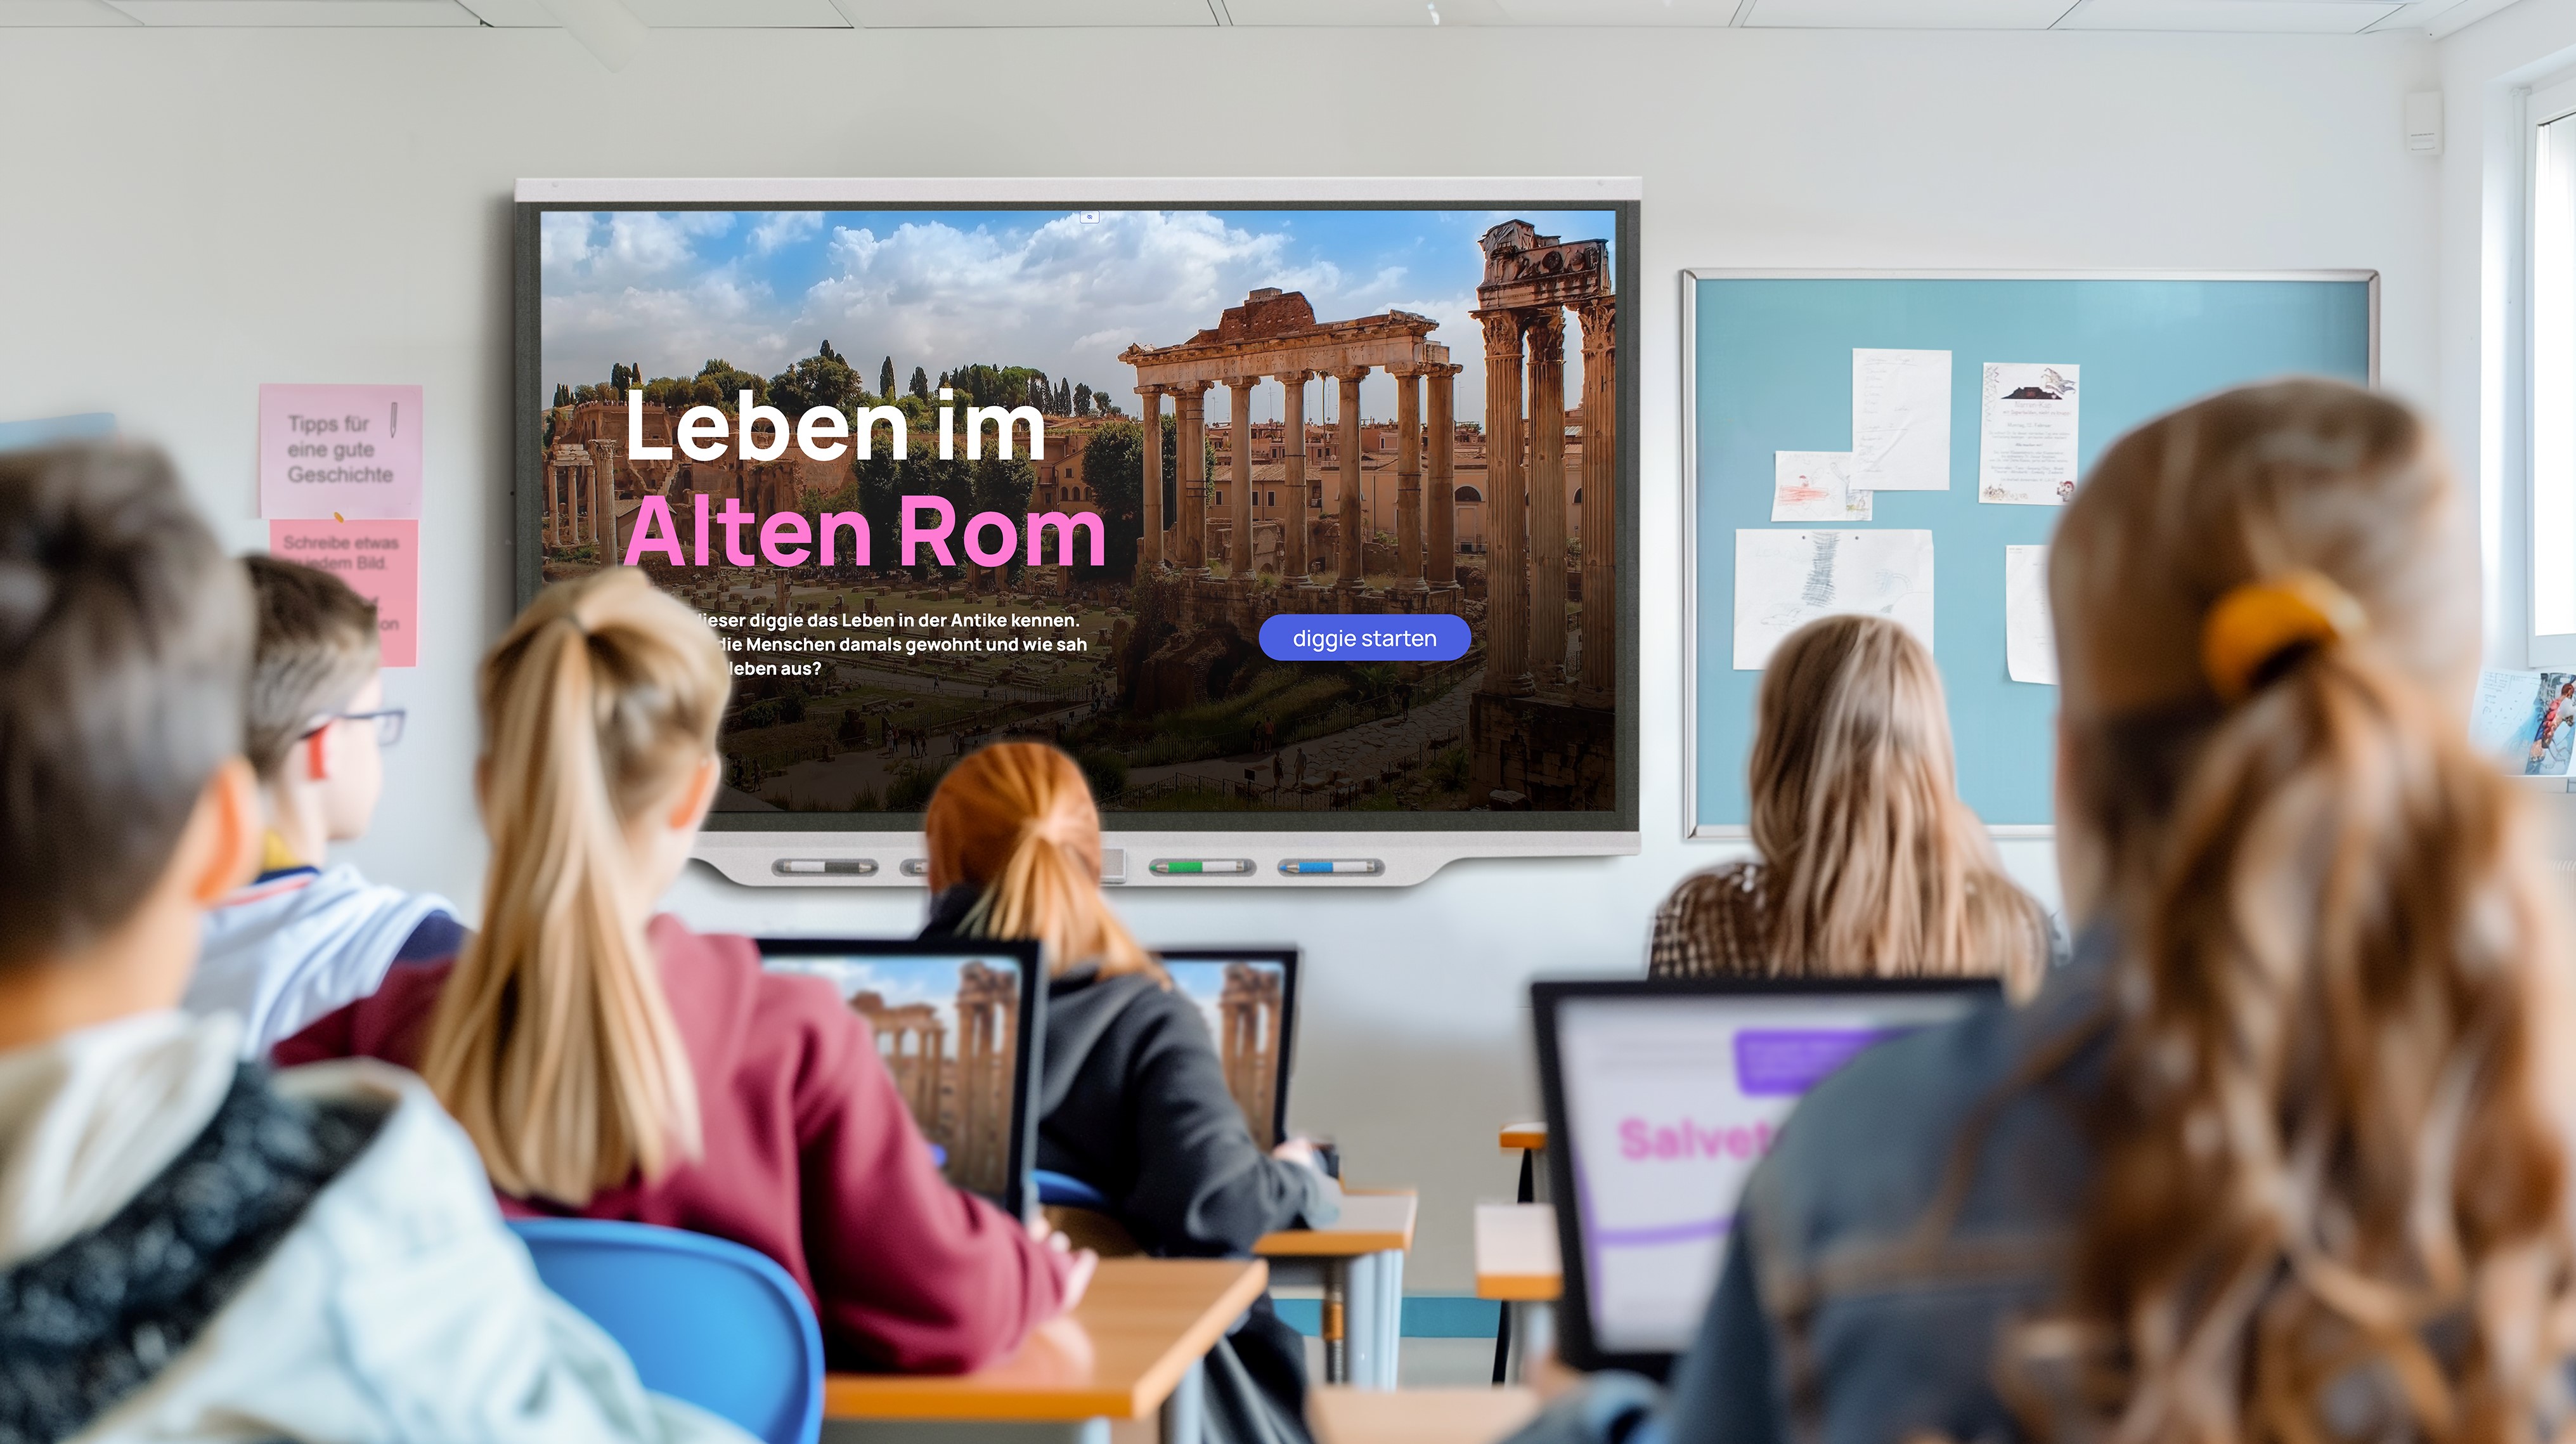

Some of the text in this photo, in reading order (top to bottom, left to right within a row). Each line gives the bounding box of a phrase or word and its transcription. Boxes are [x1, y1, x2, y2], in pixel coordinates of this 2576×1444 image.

[287, 414, 370, 436] Tipps für
[628, 387, 1045, 462] Leben im
[287, 441, 375, 462] eine gute
[287, 465, 395, 484] Geschichte
[623, 494, 1105, 568] Alten Rom
[283, 535, 400, 550] Schreibe etwas
[698, 613, 1080, 632] ieser diggie das Leben in der Antike kennen.
[717, 637, 1087, 656] die Menschen damals gewohnt und wie sah
[1293, 630, 1437, 653] diggie starten
[780, 661, 822, 675] aus?
[1617, 1117, 1785, 1161] Salvet
